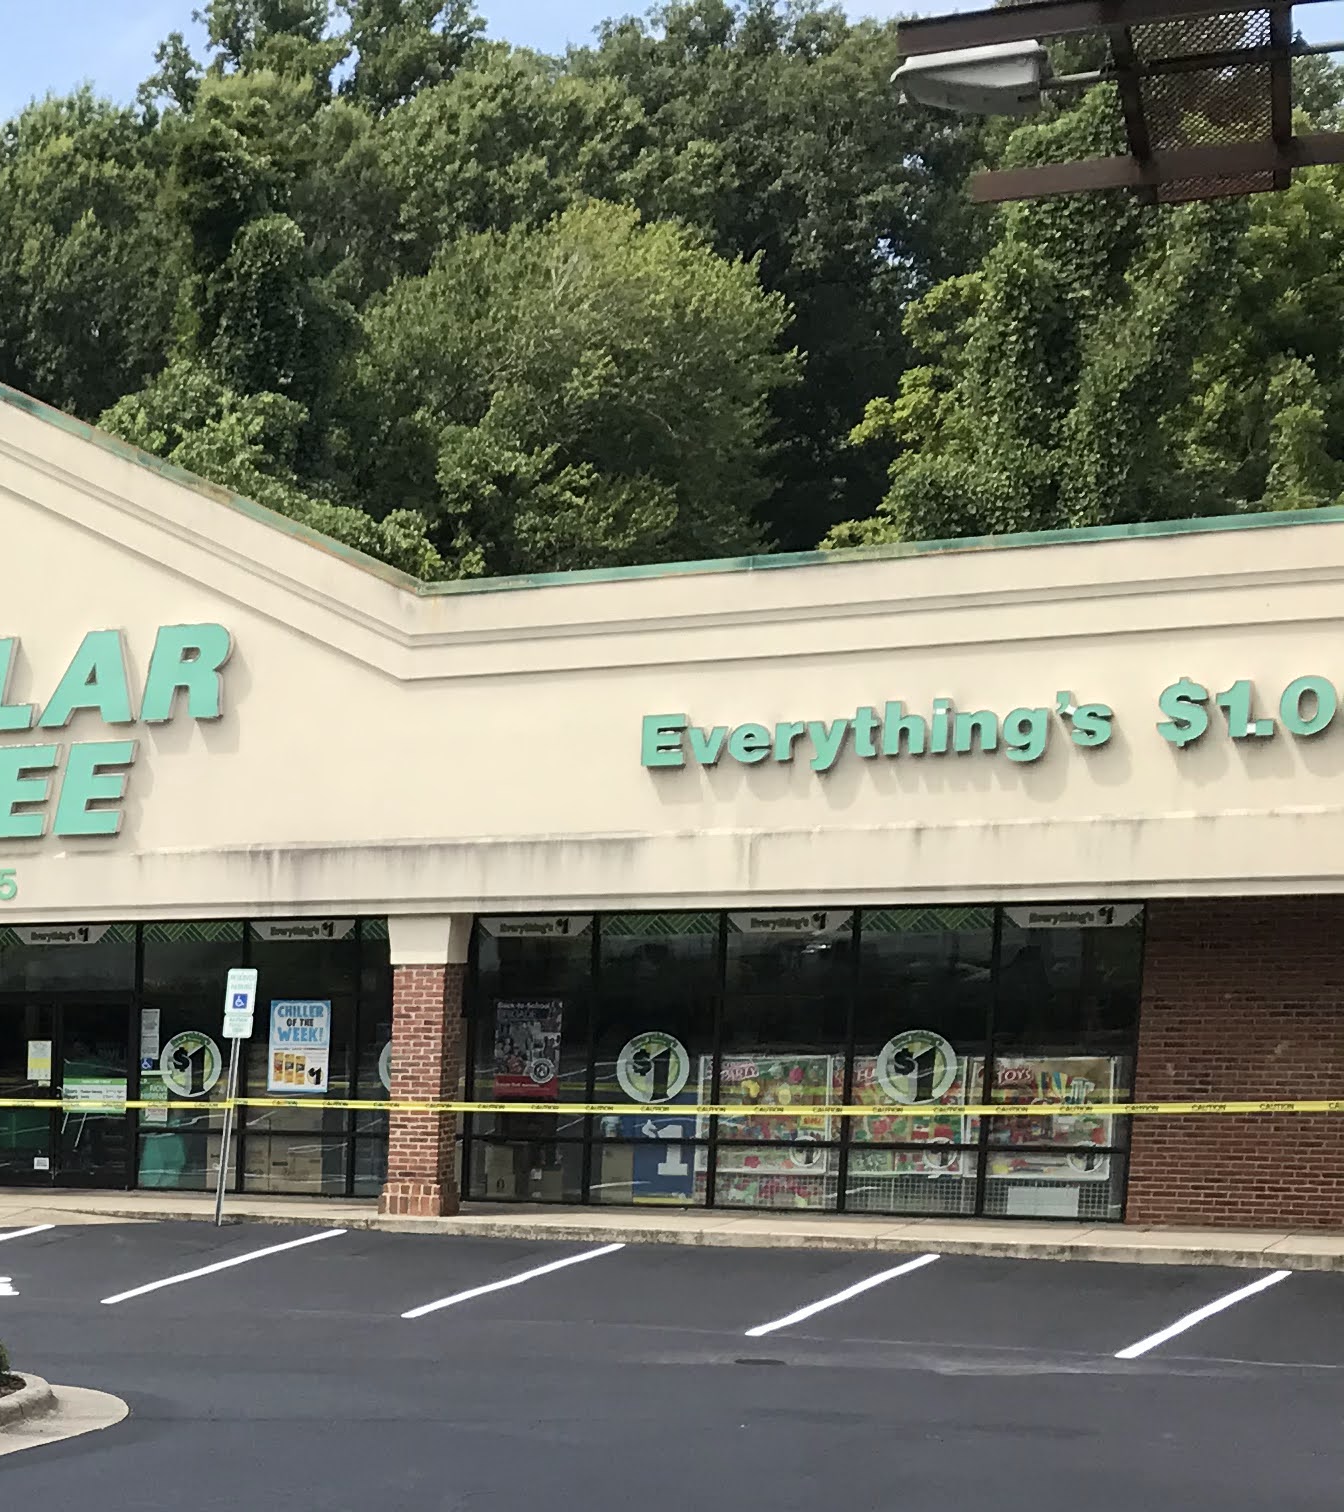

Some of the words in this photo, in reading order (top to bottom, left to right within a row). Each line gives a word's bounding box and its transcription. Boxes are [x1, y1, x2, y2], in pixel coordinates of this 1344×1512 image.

[641, 690, 1115, 772] Everything's
[1156, 676, 1339, 749] $1.0
[277, 1005, 324, 1018] CHILLER
[286, 1018, 298, 1027] OF
[299, 1018, 314, 1027] THE
[277, 1026, 324, 1043] WEEK!
[173, 1045, 206, 1095] $1
[632, 1047, 673, 1101] $1
[857, 1068, 876, 1081] FU
[894, 1046, 936, 1102] $1
[1259, 1102, 1295, 1110] CAUTION
